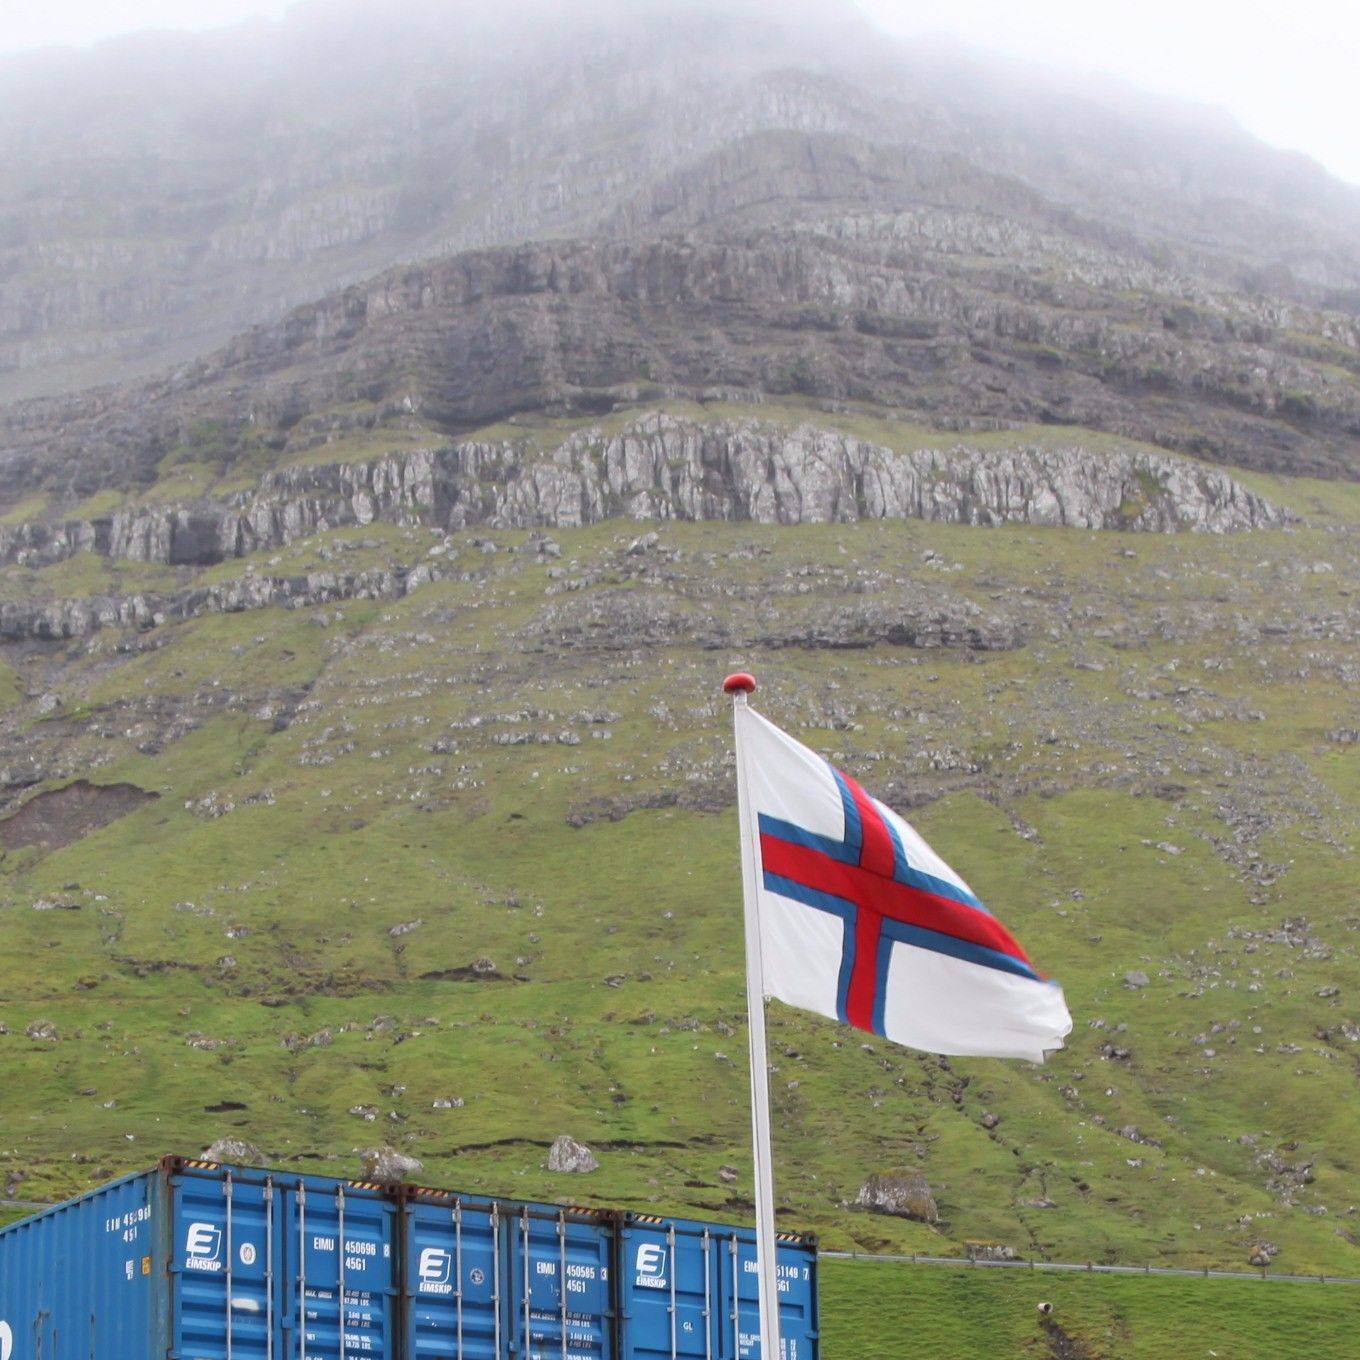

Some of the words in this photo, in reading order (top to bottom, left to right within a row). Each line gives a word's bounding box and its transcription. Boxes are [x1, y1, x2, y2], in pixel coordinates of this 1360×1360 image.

[314, 1237, 334, 1251] EIMU
[186, 1258, 221, 1271] EIMSKIP
[345, 1257, 366, 1271] 45G1
[537, 1261, 555, 1275] EIMU
[419, 1282, 452, 1294] EIMSKIP
[567, 1279, 586, 1293] 45G1
[636, 1276, 667, 1289] EIMSKIP
[683, 1321, 693, 1331] GL
